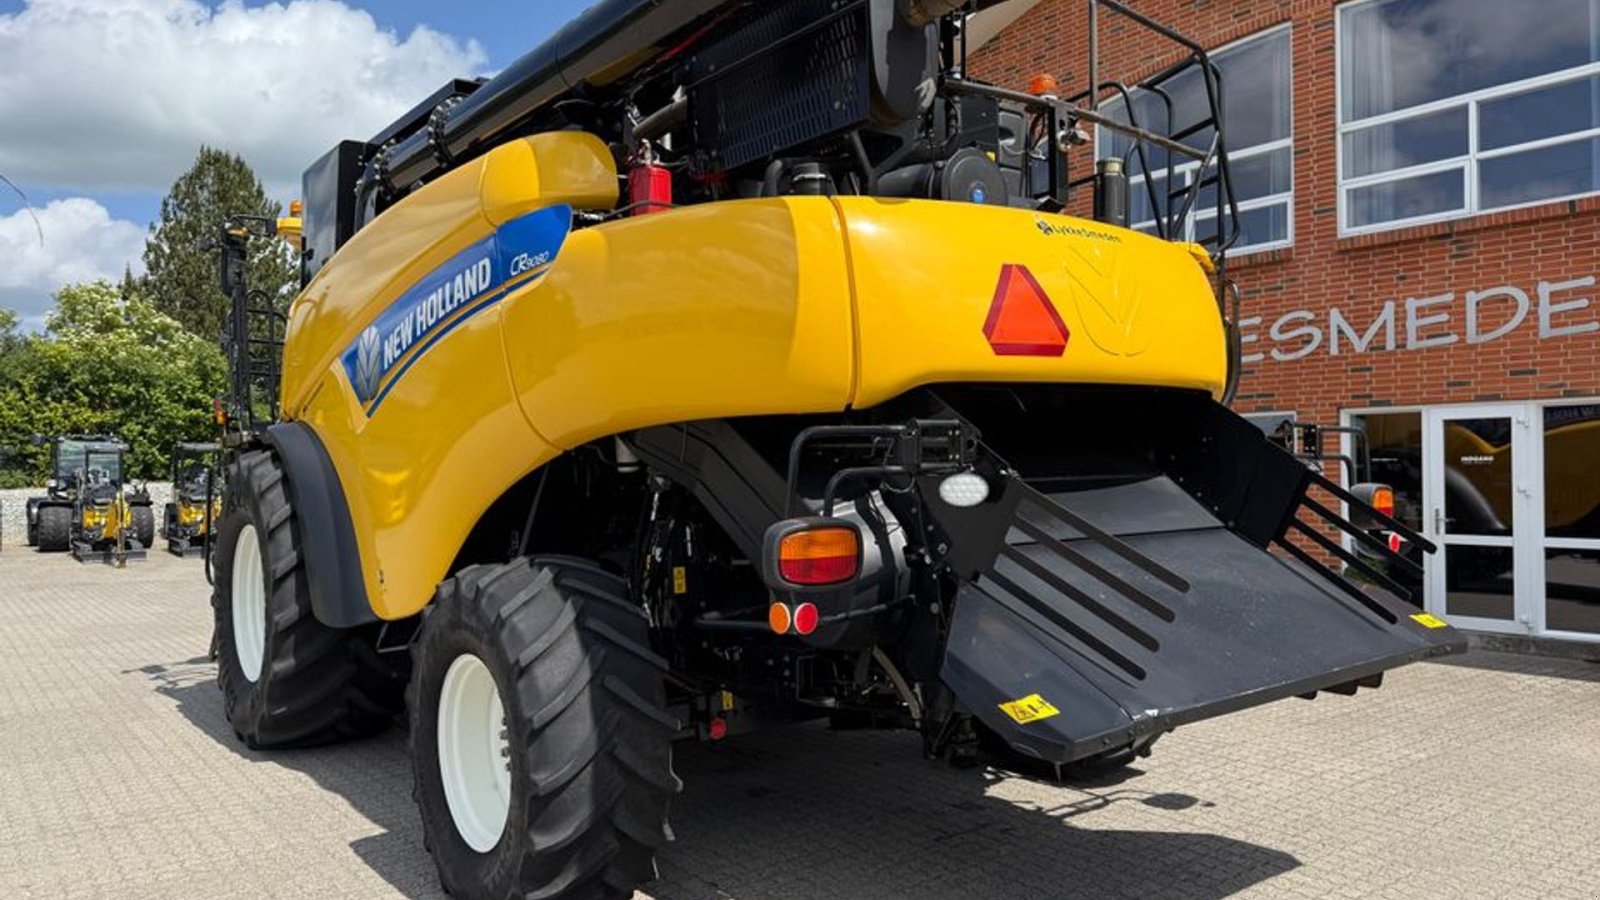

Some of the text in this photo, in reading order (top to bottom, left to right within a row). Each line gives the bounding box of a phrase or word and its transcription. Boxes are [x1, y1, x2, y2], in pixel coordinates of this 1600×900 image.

[510, 250, 549, 276] CR9080
[383, 257, 491, 369] NEW HOLLAND
